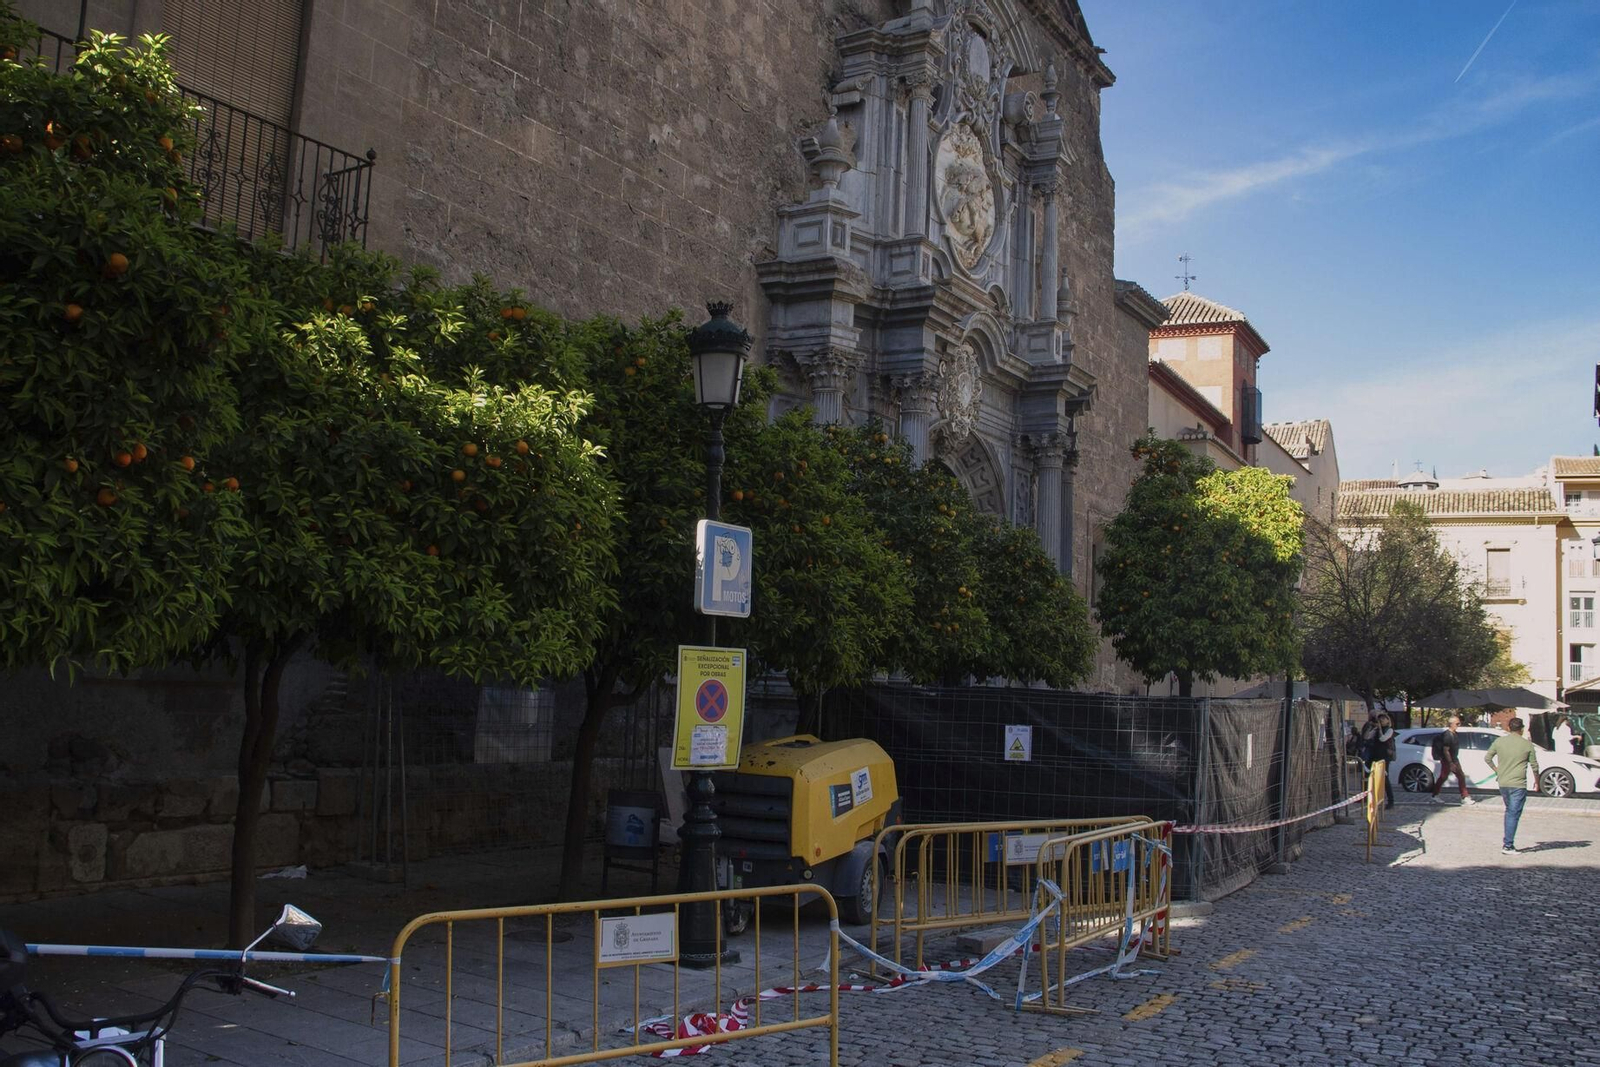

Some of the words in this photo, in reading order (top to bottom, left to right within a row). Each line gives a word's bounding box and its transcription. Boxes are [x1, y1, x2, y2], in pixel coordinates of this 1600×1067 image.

[712, 535, 741, 602] P
[723, 590, 747, 604] MOTOS
[697, 654, 730, 663] SEÑALIZACIÓN
